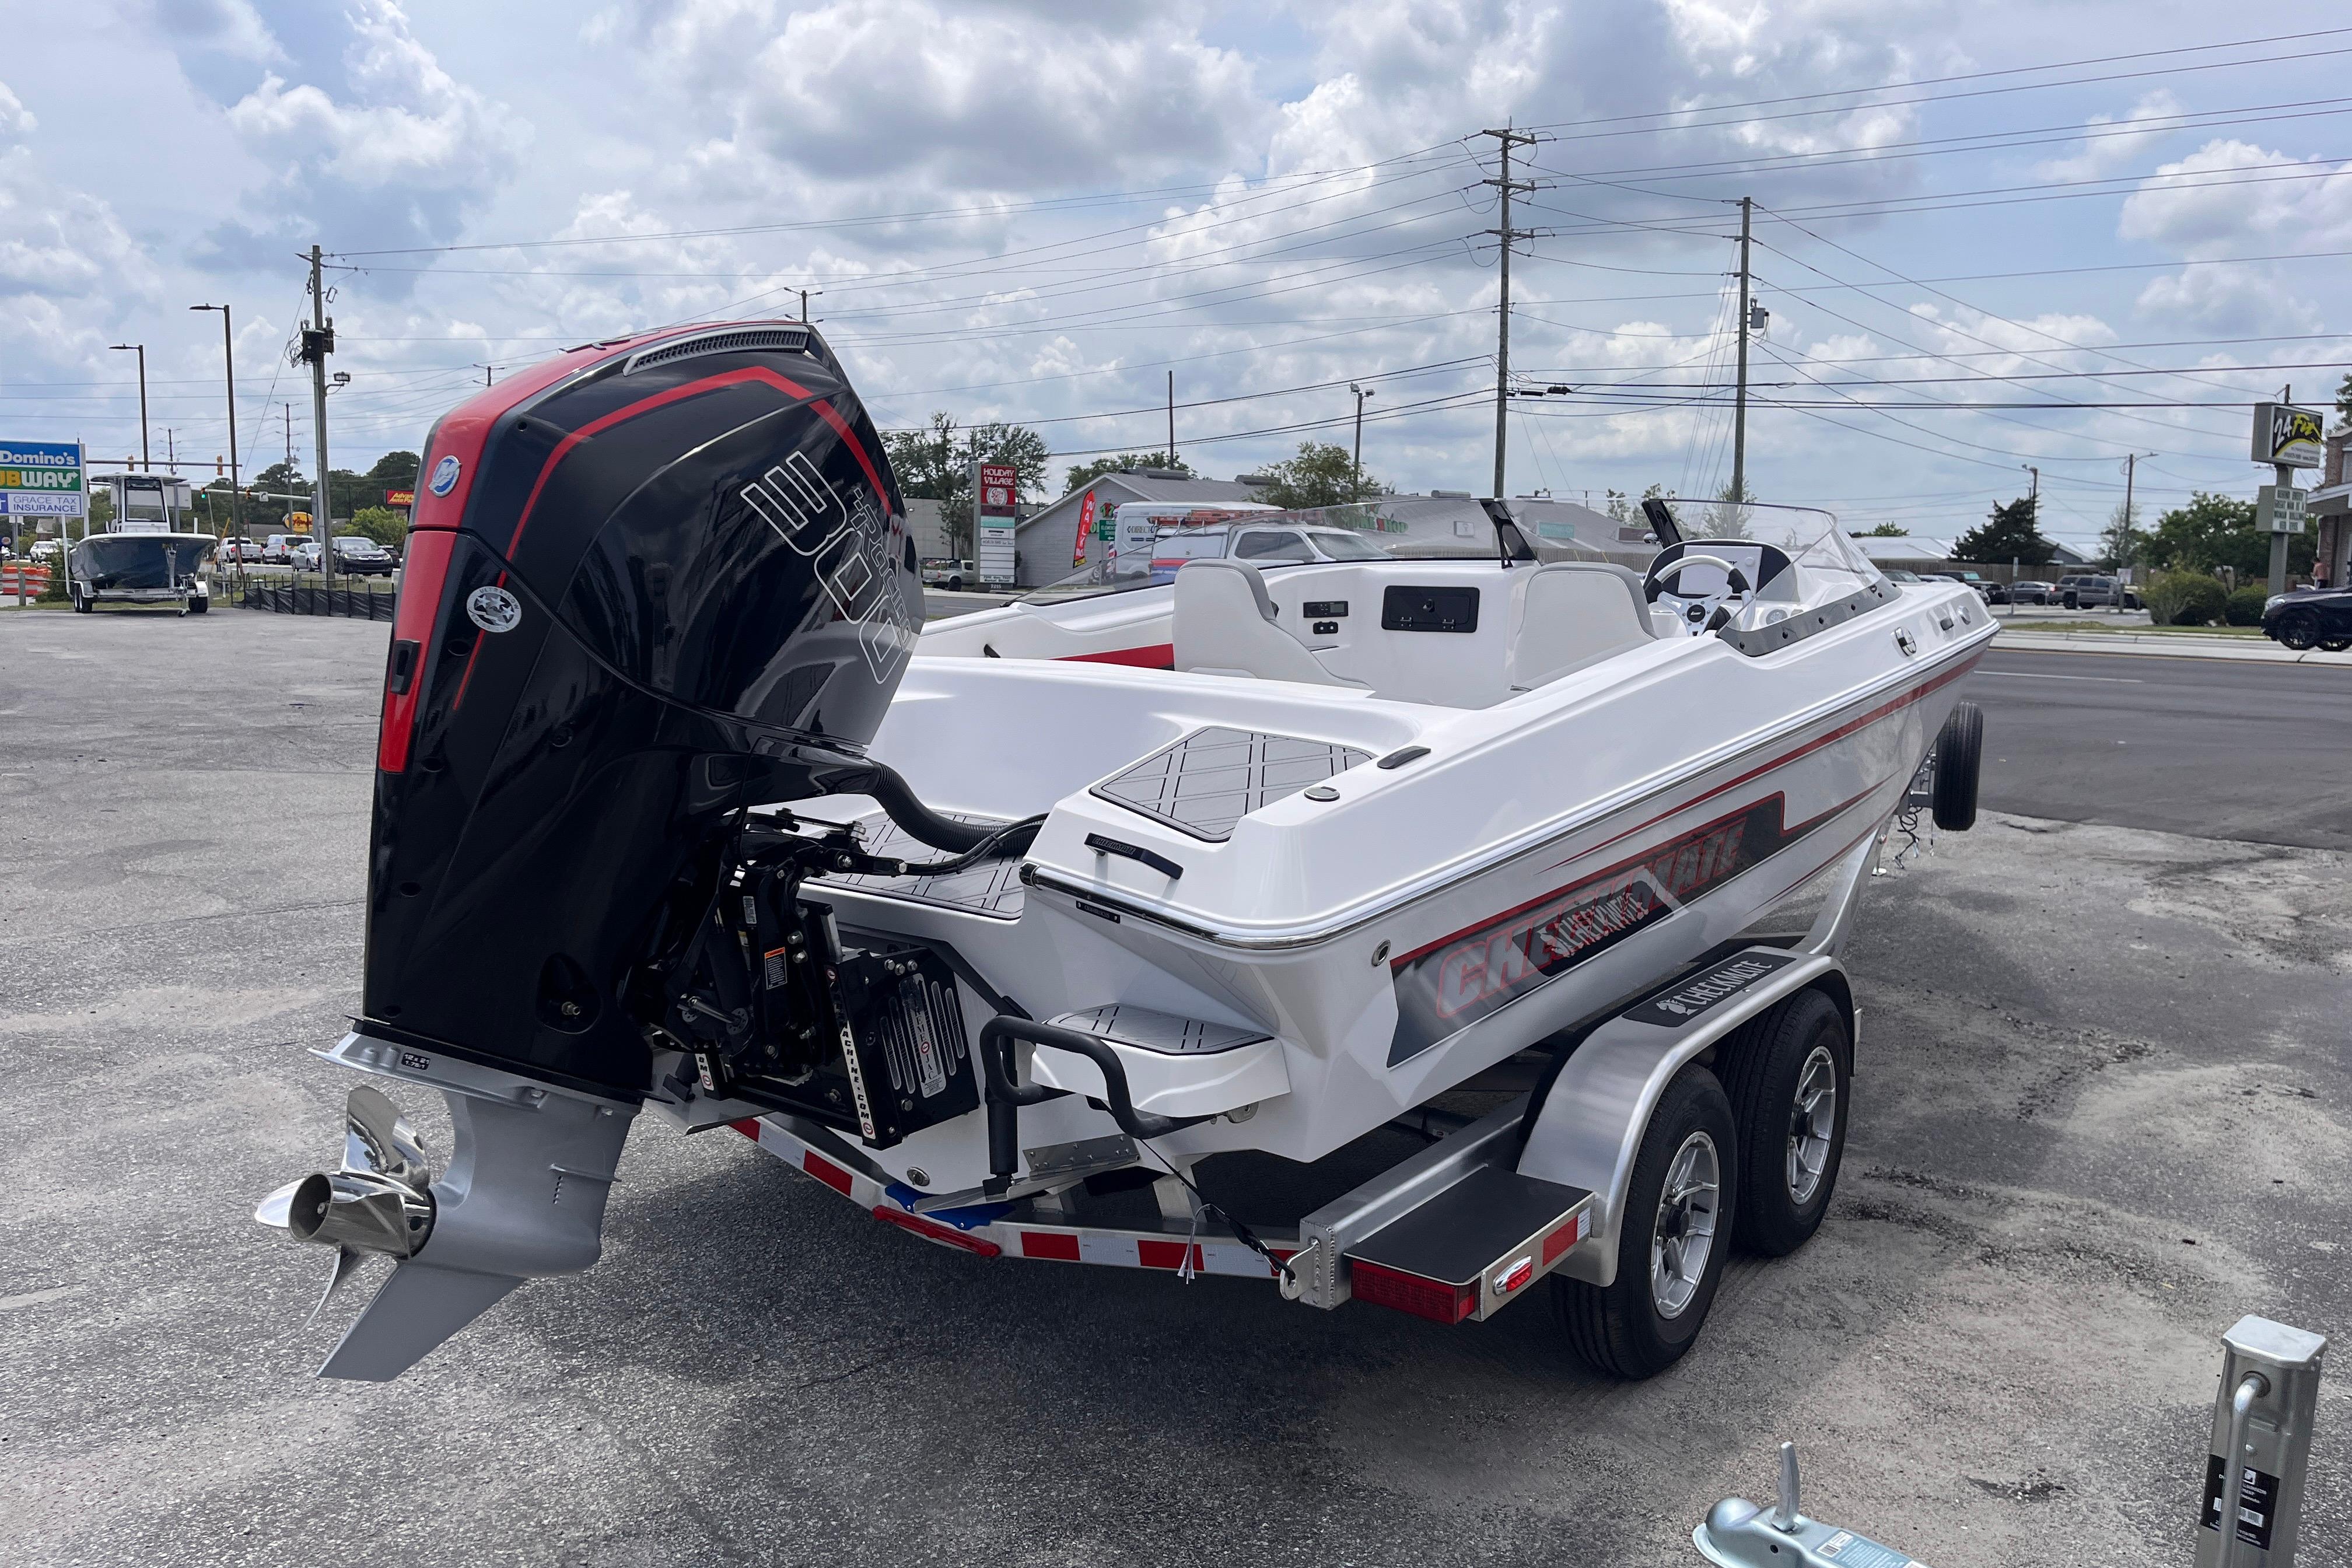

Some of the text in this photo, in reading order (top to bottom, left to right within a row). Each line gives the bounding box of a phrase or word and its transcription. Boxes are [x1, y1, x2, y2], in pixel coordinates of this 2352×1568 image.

[2274, 415, 2292, 449] 24
[0, 450, 75, 466] Domino's
[983, 468, 1014, 477] HOLIDAY
[984, 476, 1014, 485] VILLAGE
[13, 496, 51, 504] GRACE
[13, 504, 76, 512] INSURANCE
[740, 450, 904, 685] 300
[1672, 960, 1772, 1005] CHECKMATE
